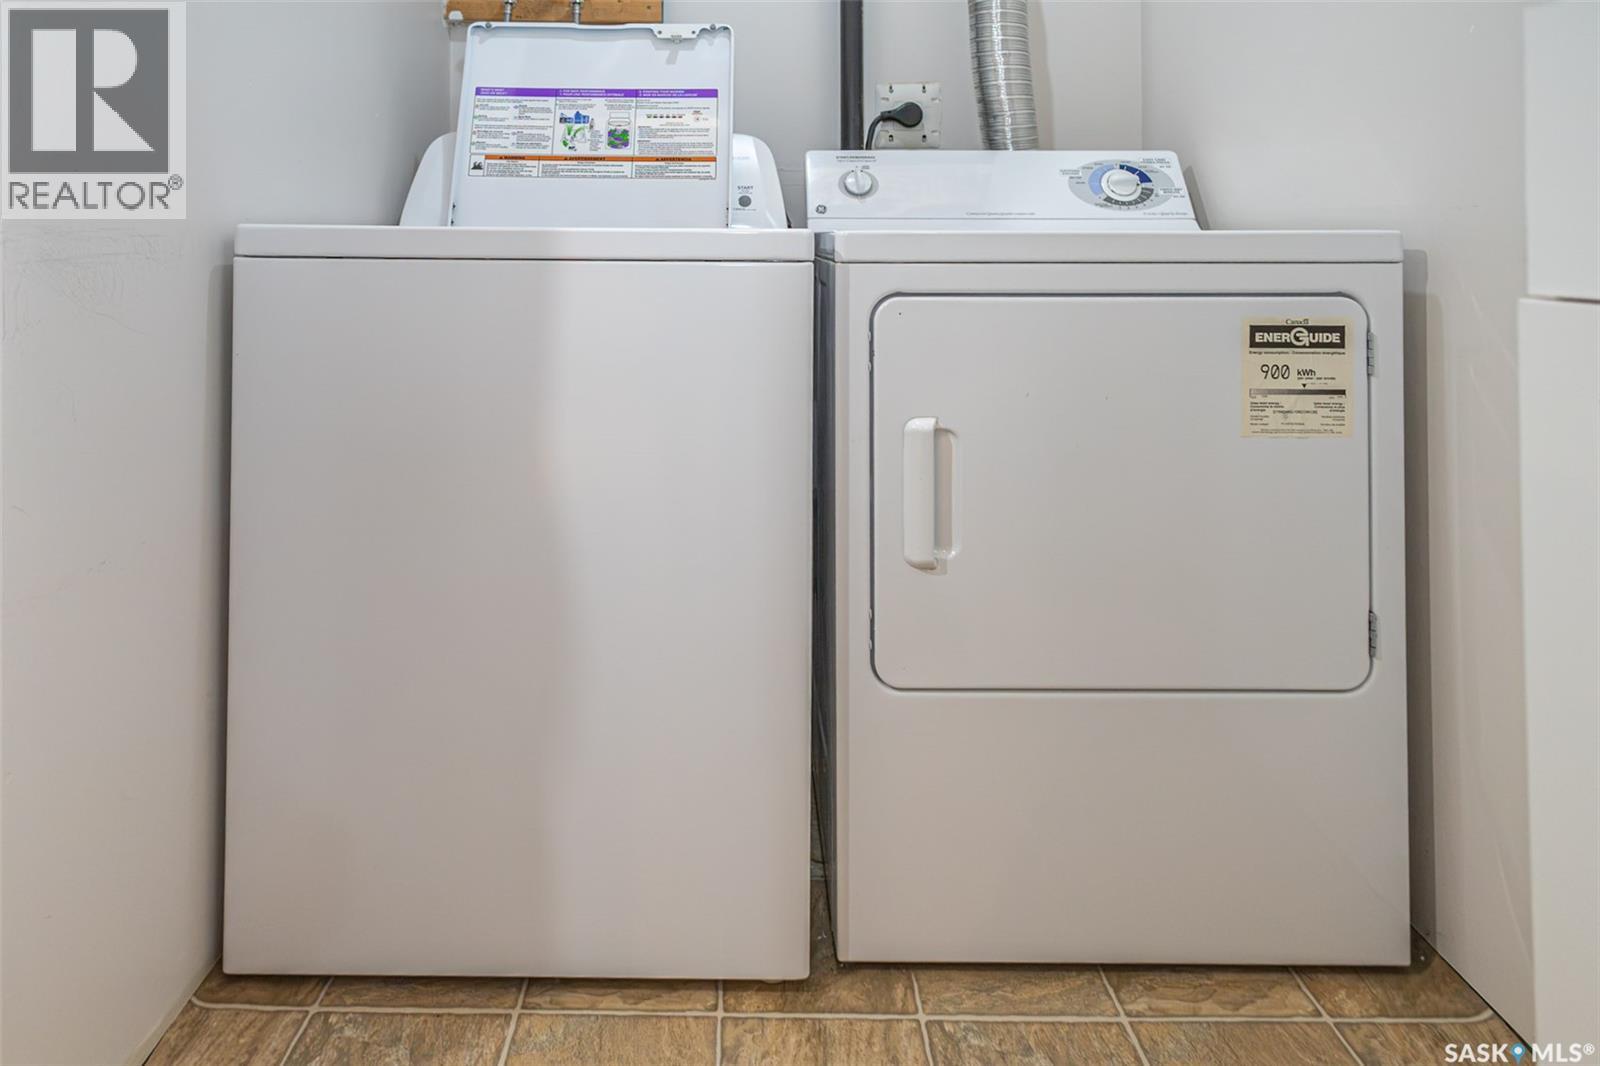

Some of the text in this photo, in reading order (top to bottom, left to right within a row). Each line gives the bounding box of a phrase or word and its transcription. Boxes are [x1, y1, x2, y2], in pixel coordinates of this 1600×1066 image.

[1255, 327, 1341, 347] ENERGUIDE
[1260, 364, 1290, 380] 900
[1297, 368, 1316, 376] kWh
